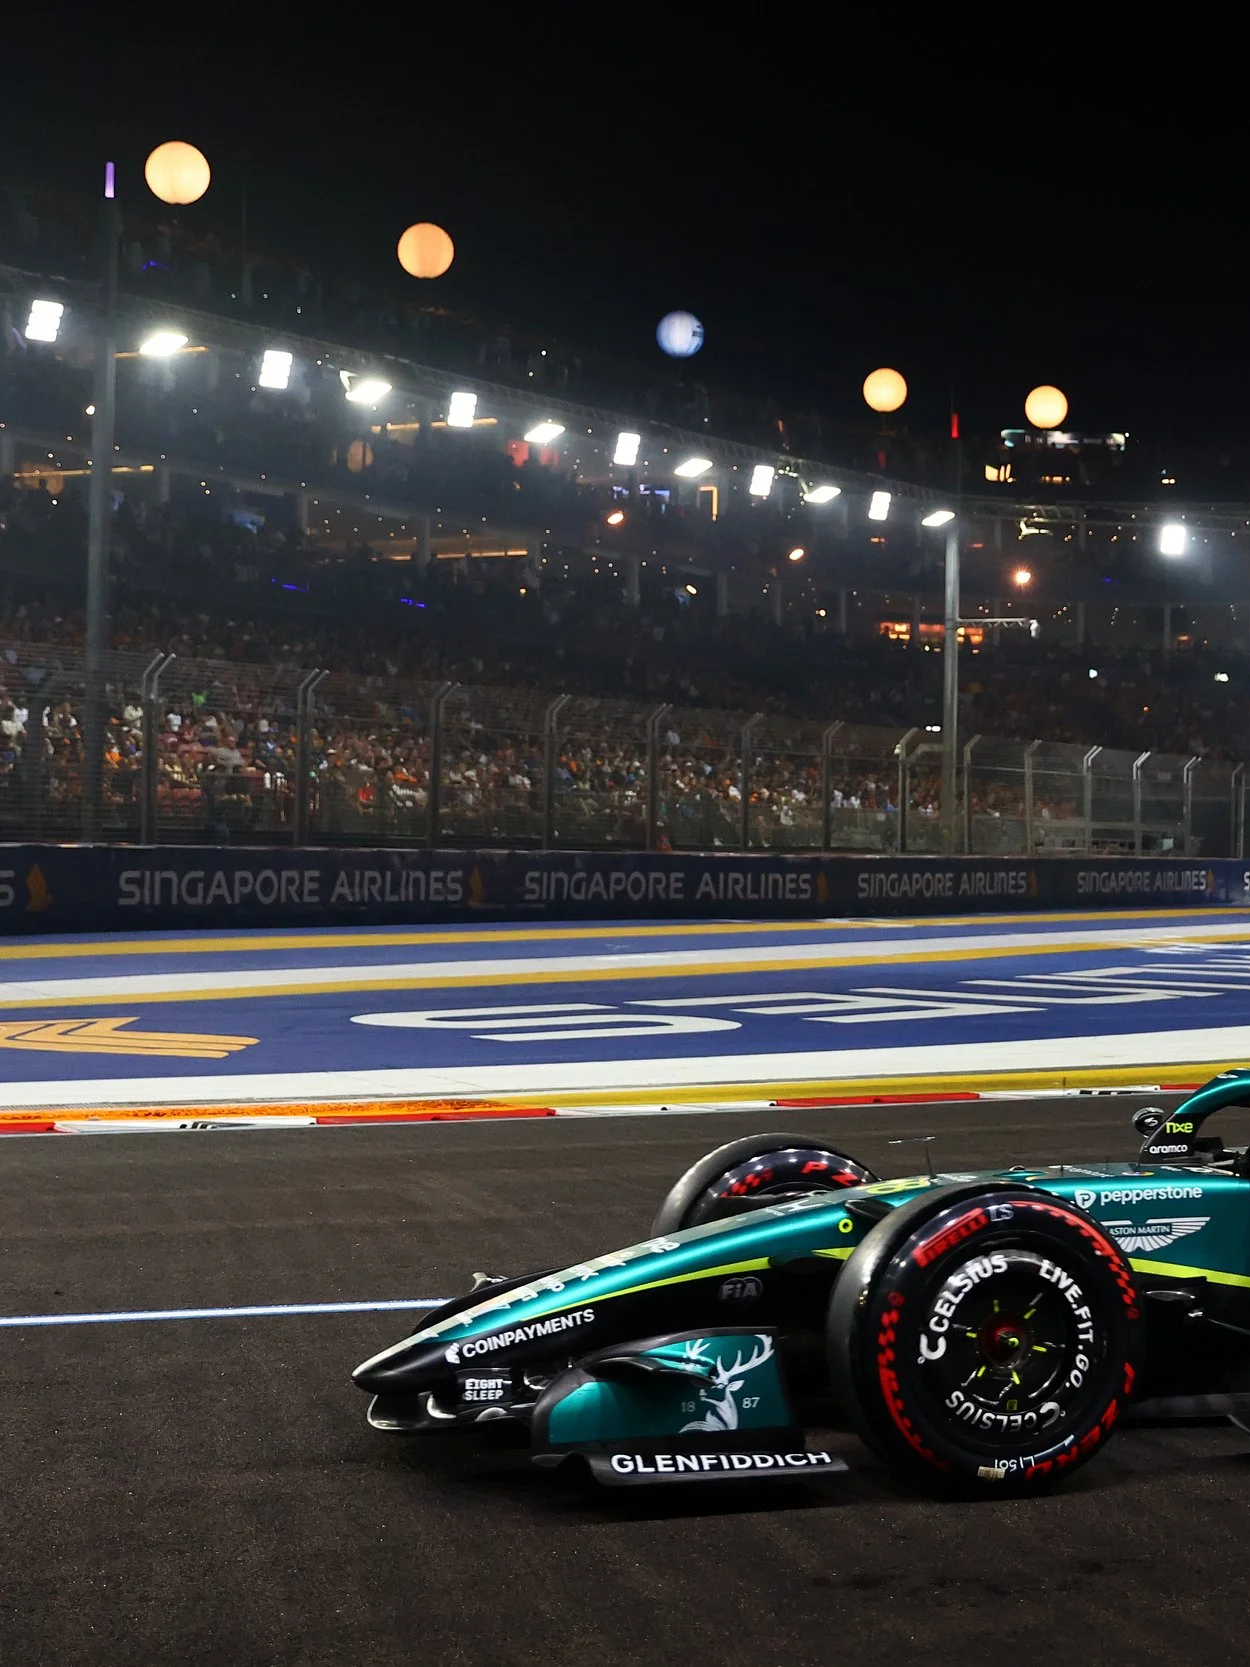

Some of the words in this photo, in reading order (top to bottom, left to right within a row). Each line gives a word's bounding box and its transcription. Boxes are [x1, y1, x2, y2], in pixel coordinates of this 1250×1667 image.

[118, 869, 320, 905] SINGAPORE
[331, 869, 463, 902] AIRLINES
[524, 871, 684, 901] SINGAPORE
[695, 871, 812, 900] AIRLINES
[857, 872, 953, 898] SINGAPORE
[958, 871, 1027, 896] AIRLINES
[1076, 870, 1153, 893] SINGAPORE
[1155, 870, 1207, 891] AIRLINES
[1149, 1144, 1188, 1154] aramco
[1100, 1185, 1202, 1204] pepperstone
[1109, 1227, 1136, 1236] ASTON
[1137, 1225, 1170, 1234] MARTIN
[721, 1280, 760, 1300] FIA
[929, 1254, 1008, 1333] CELSIUS
[462, 1309, 595, 1358] COINPAYMENTS
[465, 1378, 503, 1390] EIGHT
[465, 1389, 503, 1401] SLEEP
[742, 1397, 760, 1409] 87
[681, 1402, 696, 1413] 18
[945, 1390, 1038, 1432] CELSIUS
[611, 1451, 832, 1475] GLENFIDDICH
